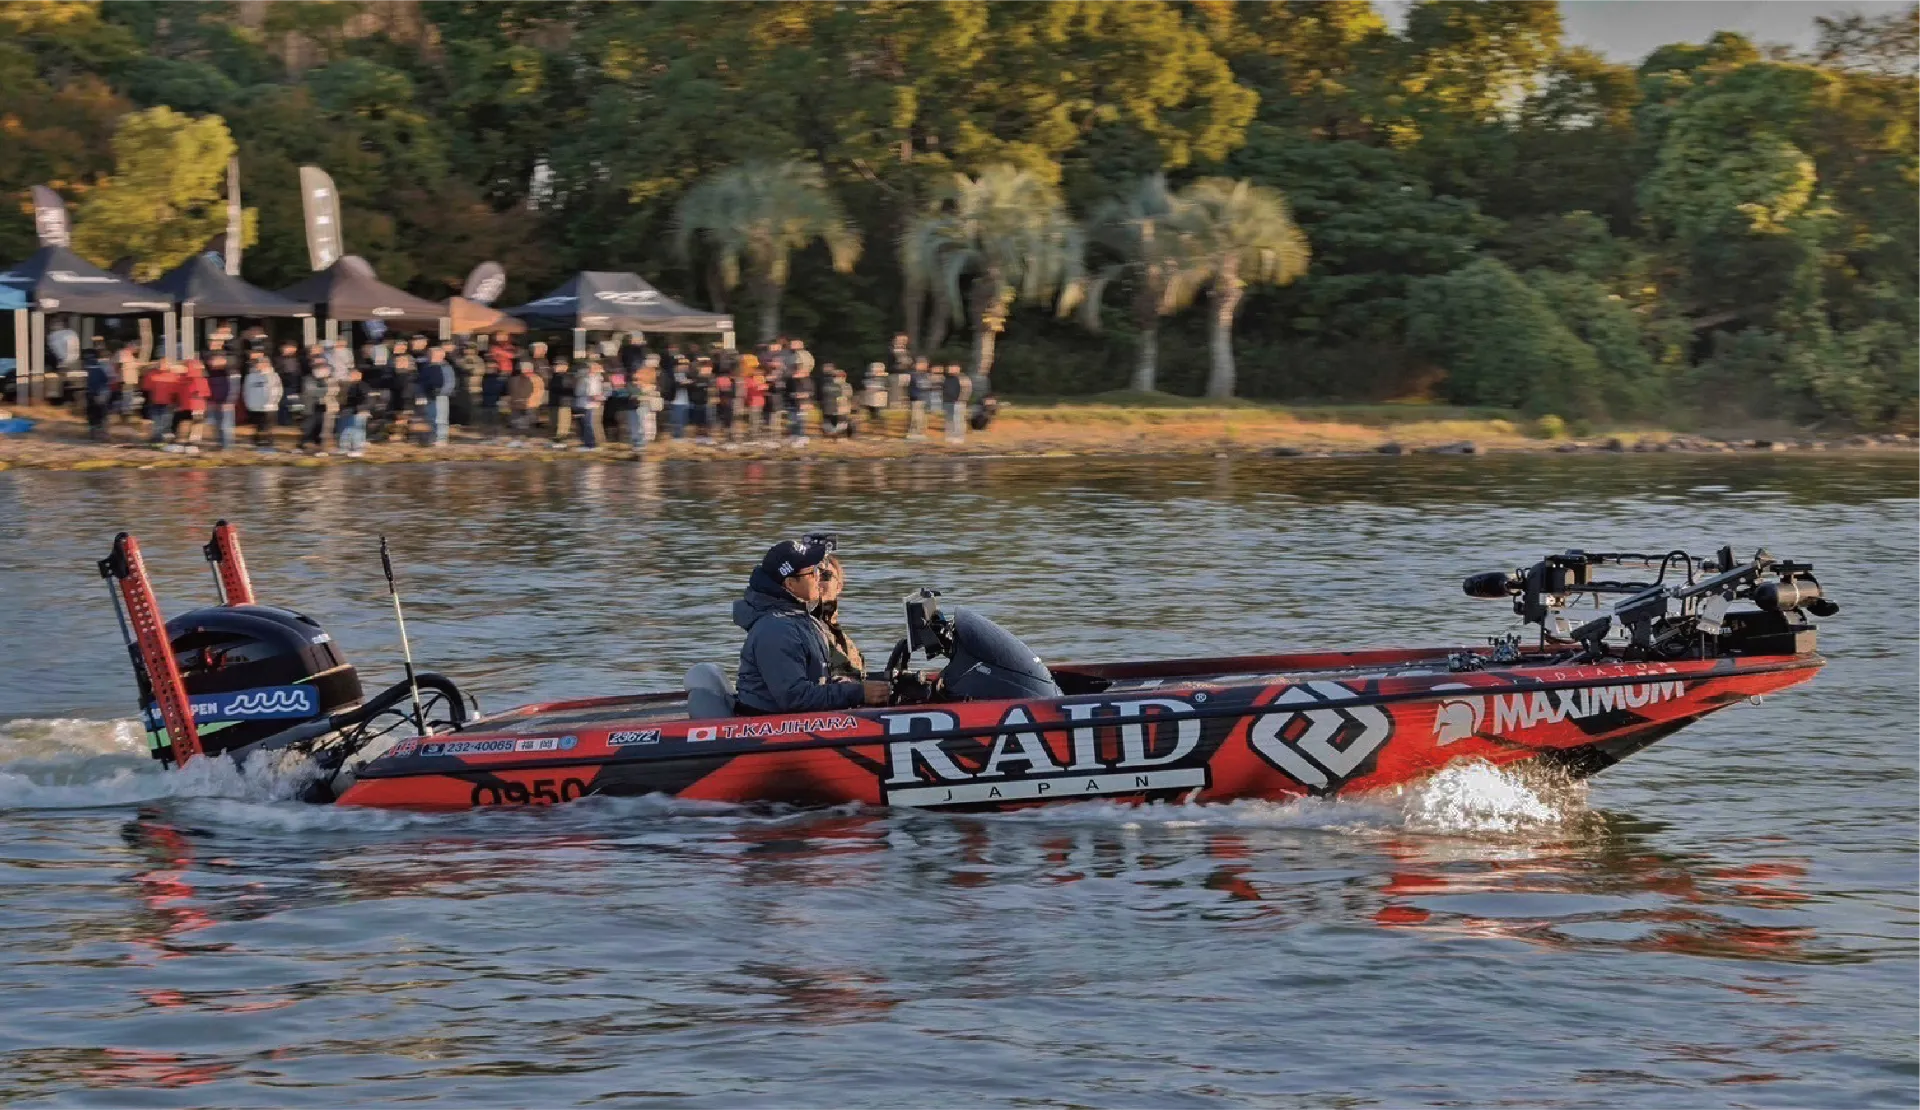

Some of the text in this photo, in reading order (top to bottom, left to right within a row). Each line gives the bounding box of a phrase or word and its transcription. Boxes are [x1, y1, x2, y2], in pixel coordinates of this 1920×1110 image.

[1490, 662, 1669, 687] ADIATOR
[190, 702, 218, 717] PEN
[1493, 667, 1686, 735] MAXIMUM
[723, 716, 858, 739] T.KAJIHARA
[880, 698, 1201, 785] RAID
[471, 777, 586, 808] 0950
[943, 774, 1150, 803] JAPAN
